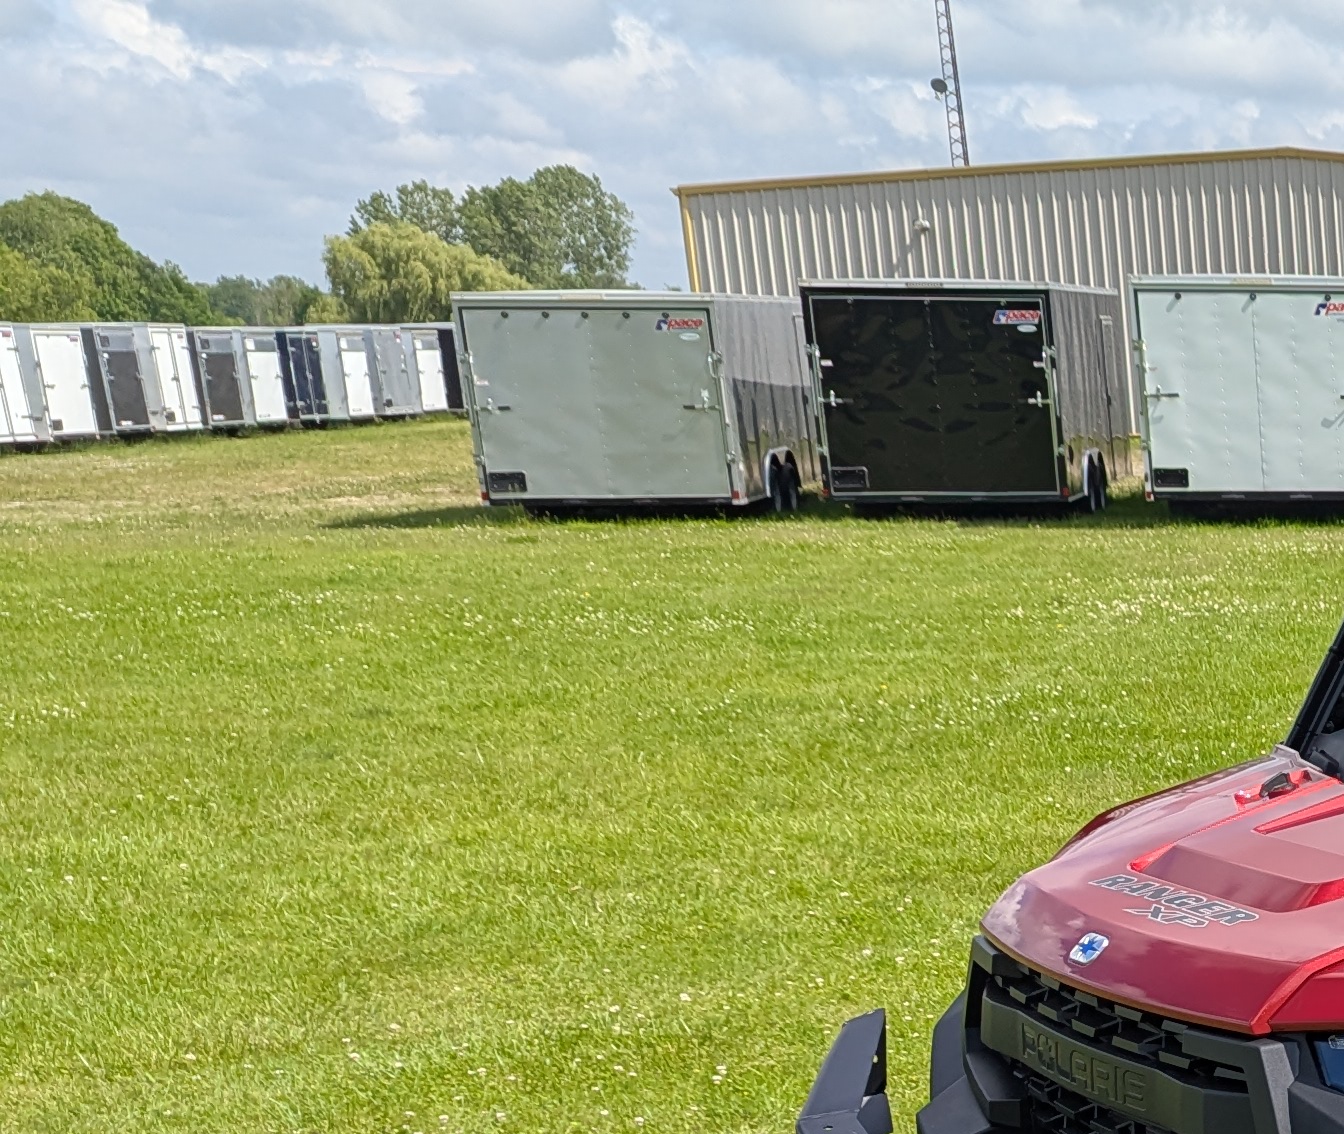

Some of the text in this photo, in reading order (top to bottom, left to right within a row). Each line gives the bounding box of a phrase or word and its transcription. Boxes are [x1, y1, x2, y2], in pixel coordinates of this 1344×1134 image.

[1088, 874, 1260, 926] RANGER
[1122, 904, 1210, 928] XP
[1021, 1022, 1147, 1112] POLARIS
